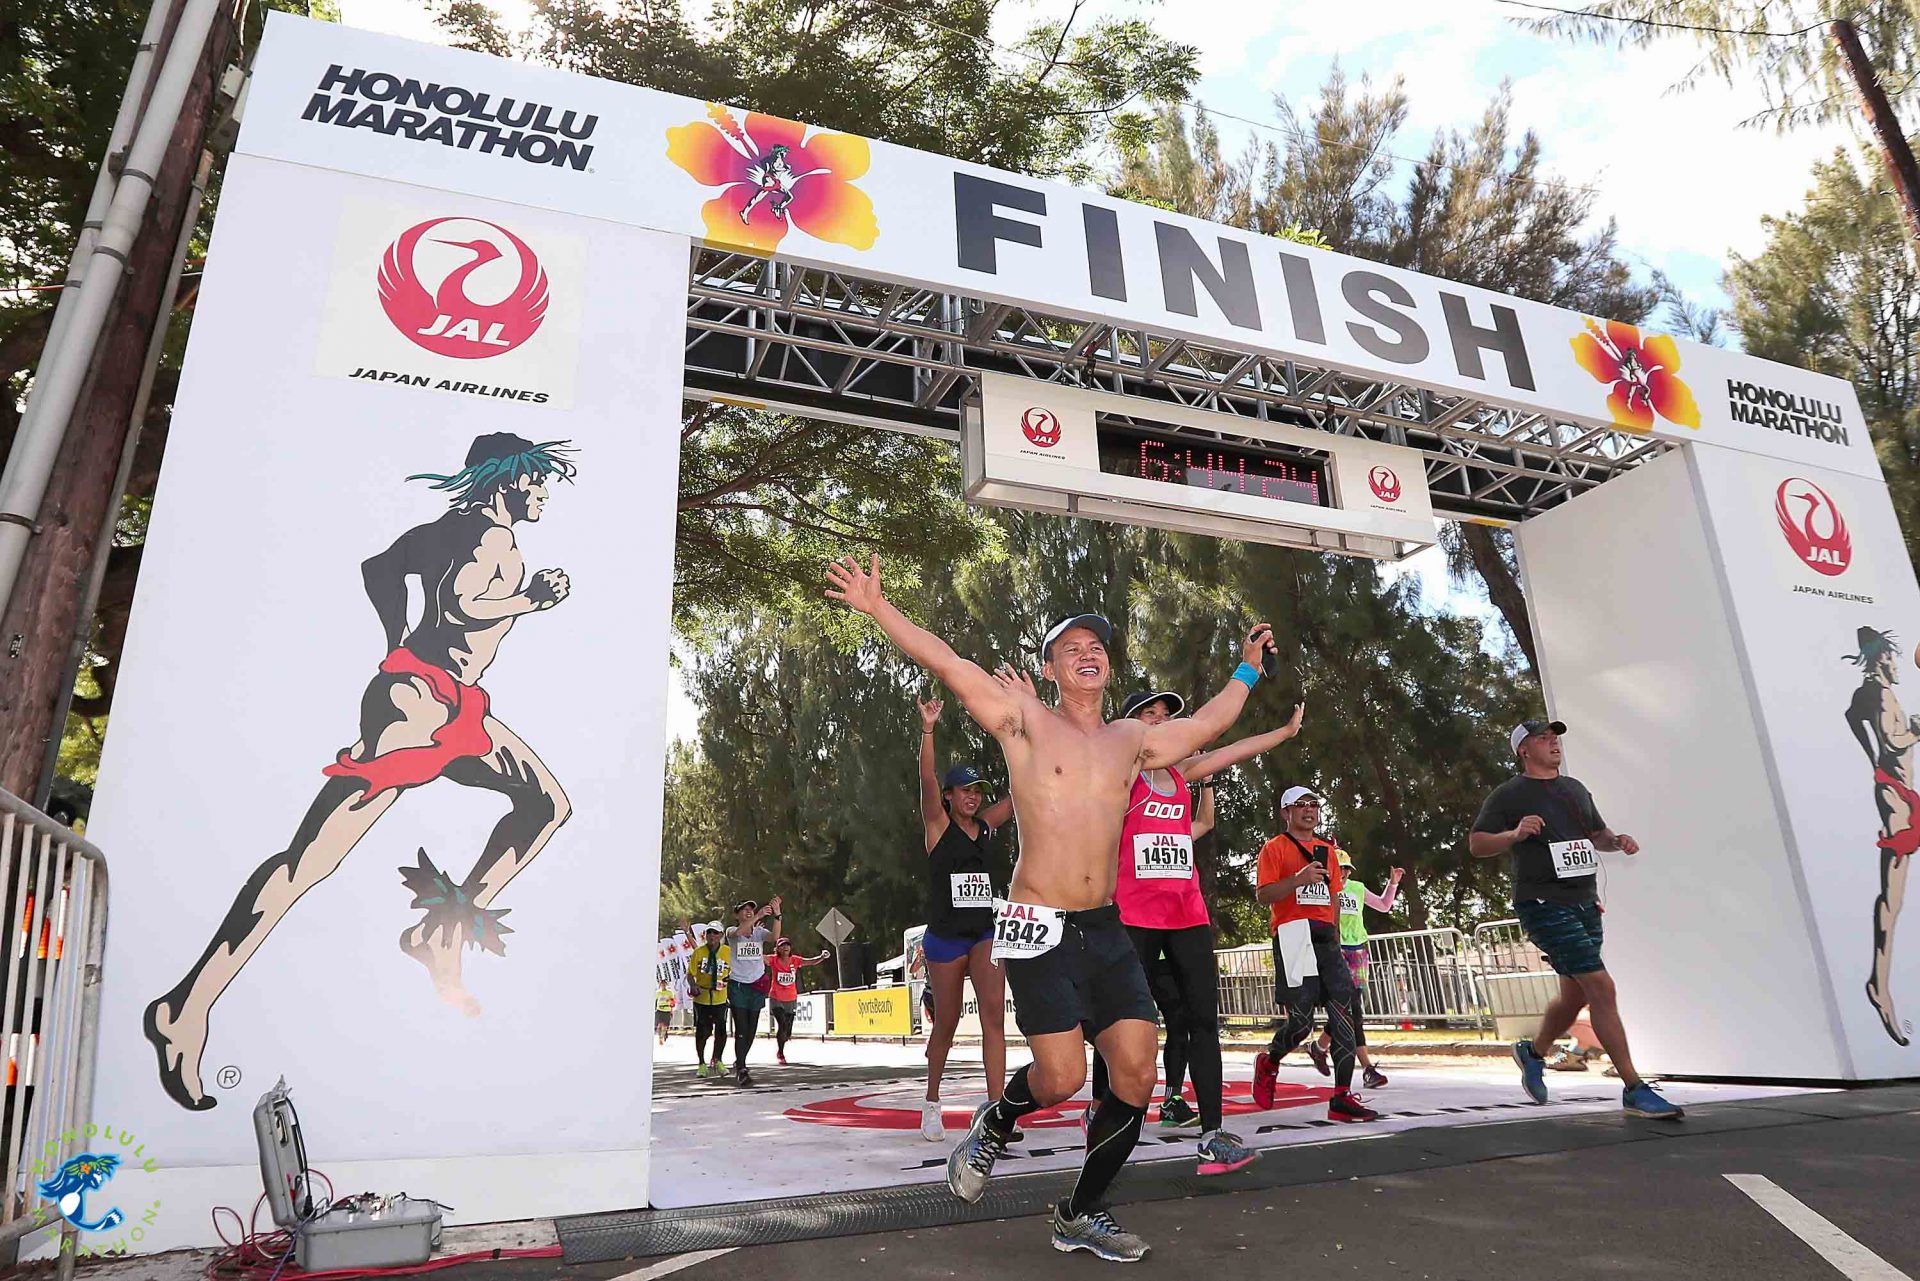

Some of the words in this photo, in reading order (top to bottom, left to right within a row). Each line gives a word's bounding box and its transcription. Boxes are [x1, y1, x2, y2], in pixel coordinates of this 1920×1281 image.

[318, 64, 598, 140] HONOLULU
[301, 93, 595, 171] MARATHON
[953, 171, 1536, 392] FINISH
[417, 314, 510, 346] JAL
[348, 368, 430, 387] JAPAN
[434, 380, 549, 403] AIRLINES
[1727, 379, 1842, 424] HONOLULU
[1730, 401, 1849, 446] MARATHON
[1032, 435, 1054, 444] JAL
[1379, 491, 1397, 499] JAL
[1806, 546, 1846, 566] JAL
[1793, 585, 1825, 596] JAPAN
[1828, 591, 1874, 604] AIRLINES
[1152, 835, 1178, 847] JAL
[1566, 841, 1587, 851] JAL
[1142, 847, 1188, 865] 14579
[1562, 850, 1593, 866] 5601
[965, 875, 985, 883] JAL
[957, 884, 990, 897] 13725
[1000, 904, 1039, 922] JAL
[997, 919, 1049, 945] 1342
[858, 998, 893, 1018] SportsBeauty
